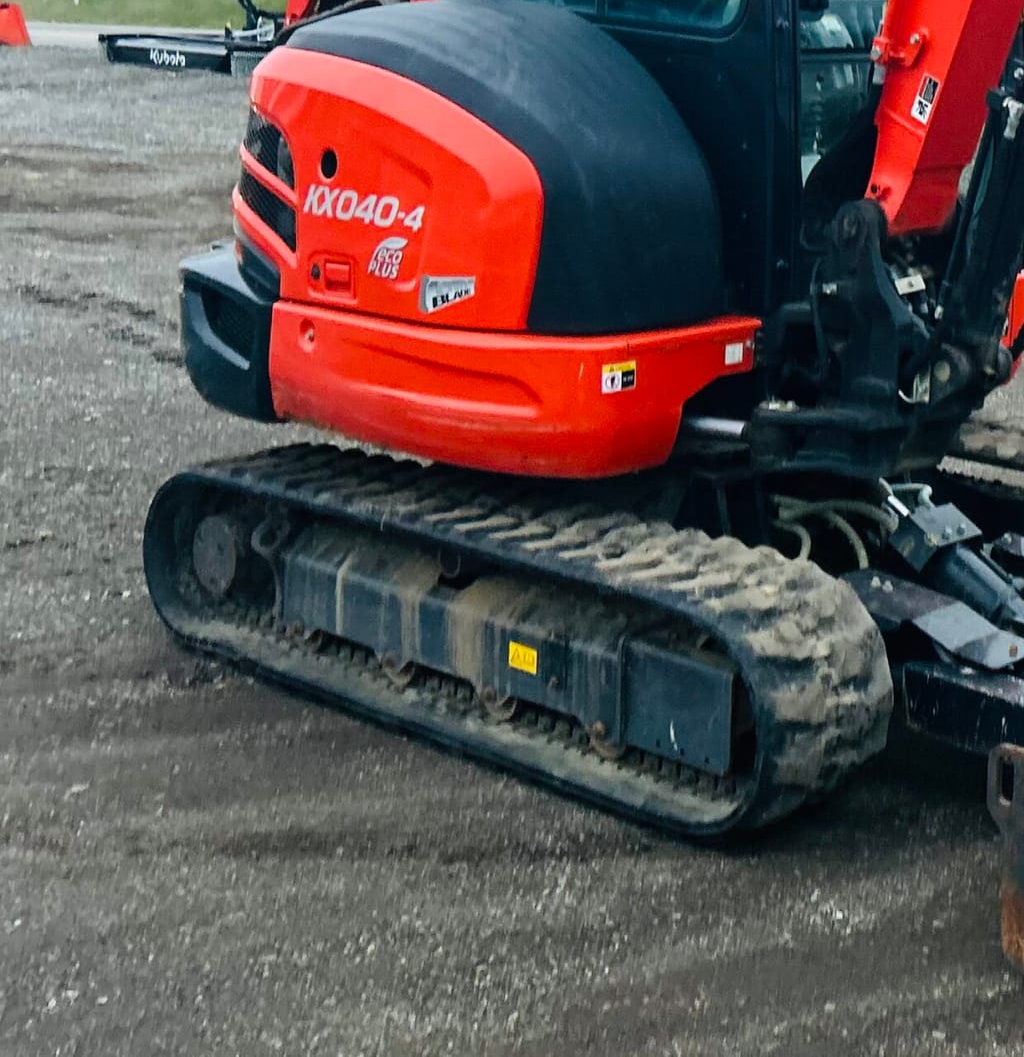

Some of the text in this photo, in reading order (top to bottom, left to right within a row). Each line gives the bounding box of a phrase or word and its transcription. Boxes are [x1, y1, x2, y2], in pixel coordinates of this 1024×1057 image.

[150, 47, 186, 67] Kubota
[303, 183, 424, 232] KX040-4
[377, 248, 403, 264] eco
[368, 260, 400, 280] PLUS
